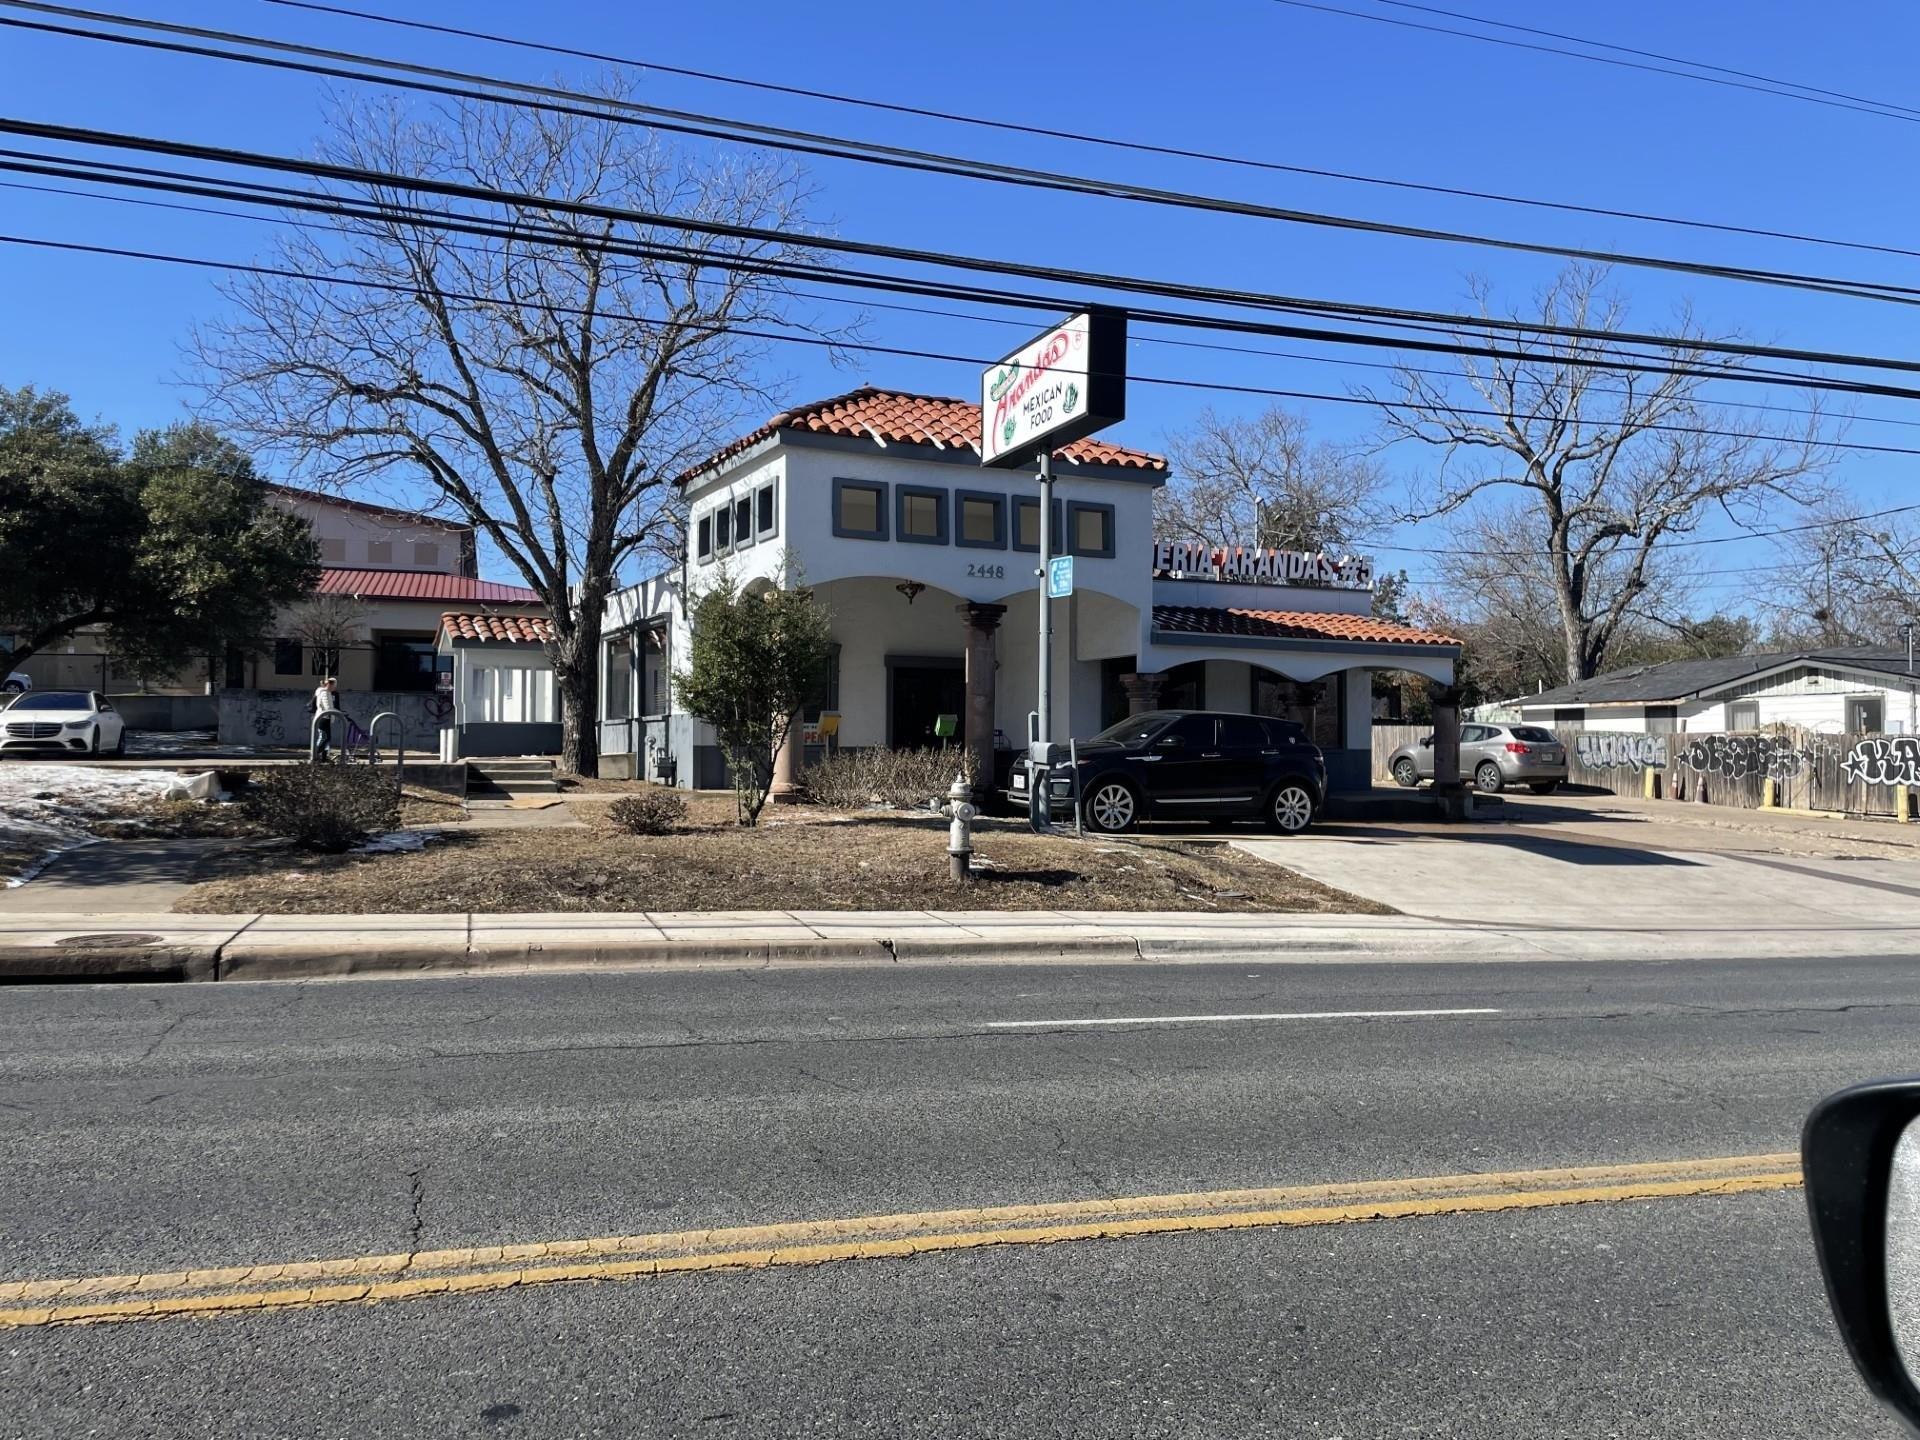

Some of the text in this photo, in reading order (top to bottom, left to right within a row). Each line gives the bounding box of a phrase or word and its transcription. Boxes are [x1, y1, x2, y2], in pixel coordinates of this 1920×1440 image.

[1023, 381, 1063, 416] MEXICAN
[1030, 406, 1053, 430] FOOD
[967, 563, 1004, 578] 2448
[1154, 541, 1375, 583] ERIA ARANDAS #5
